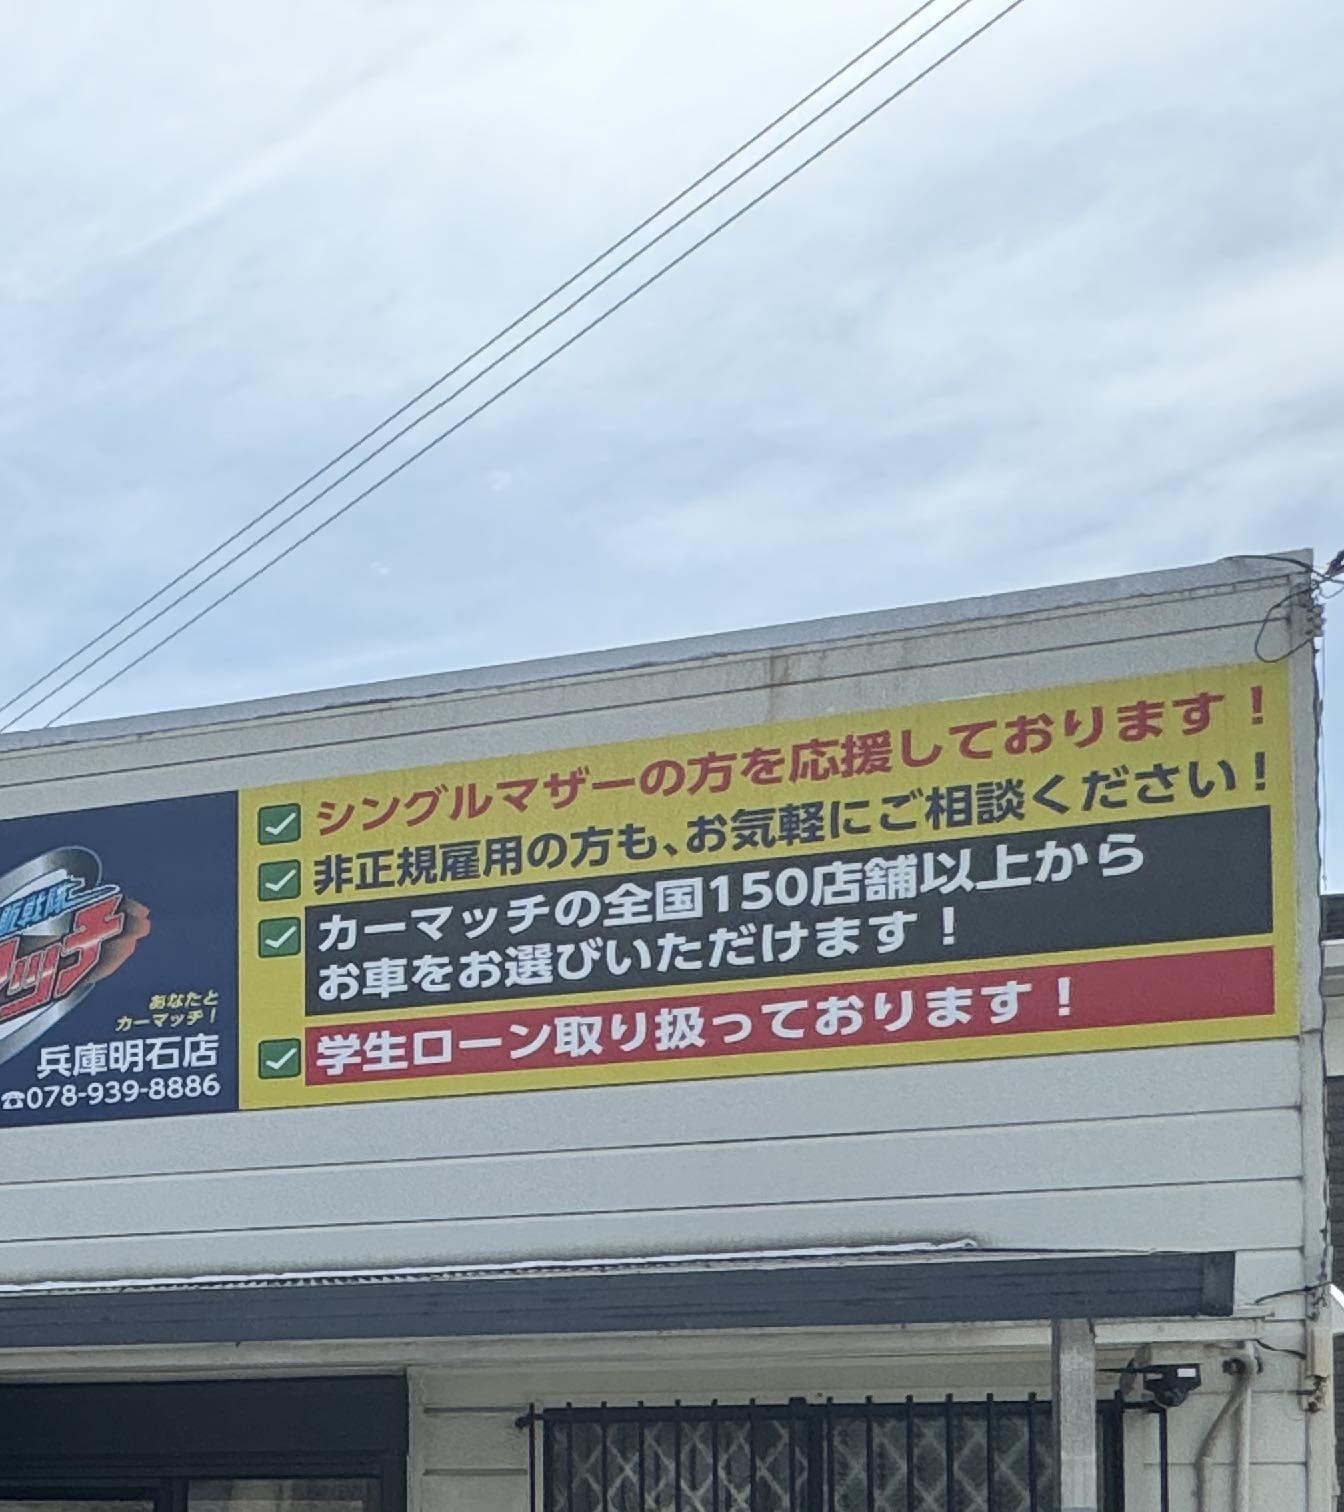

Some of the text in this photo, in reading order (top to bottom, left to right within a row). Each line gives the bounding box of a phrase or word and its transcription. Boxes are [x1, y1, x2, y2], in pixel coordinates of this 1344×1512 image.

[315, 685, 1265, 836] シングルマザーの方を応援しております！
[313, 751, 1267, 896] 非正規雇用の方も、お気軽にご相談ください！
[317, 833, 1145, 952] カーマッチの全国150店舗以上から
[148, 989, 219, 1010] あなたと
[317, 906, 957, 1001] お車をお選びいただけます！
[36, 1033, 220, 1081] 兵庫明石店
[316, 976, 1073, 1076] 学生ローン取り扱っております！
[26, 1072, 222, 1111] 078-939-8886
